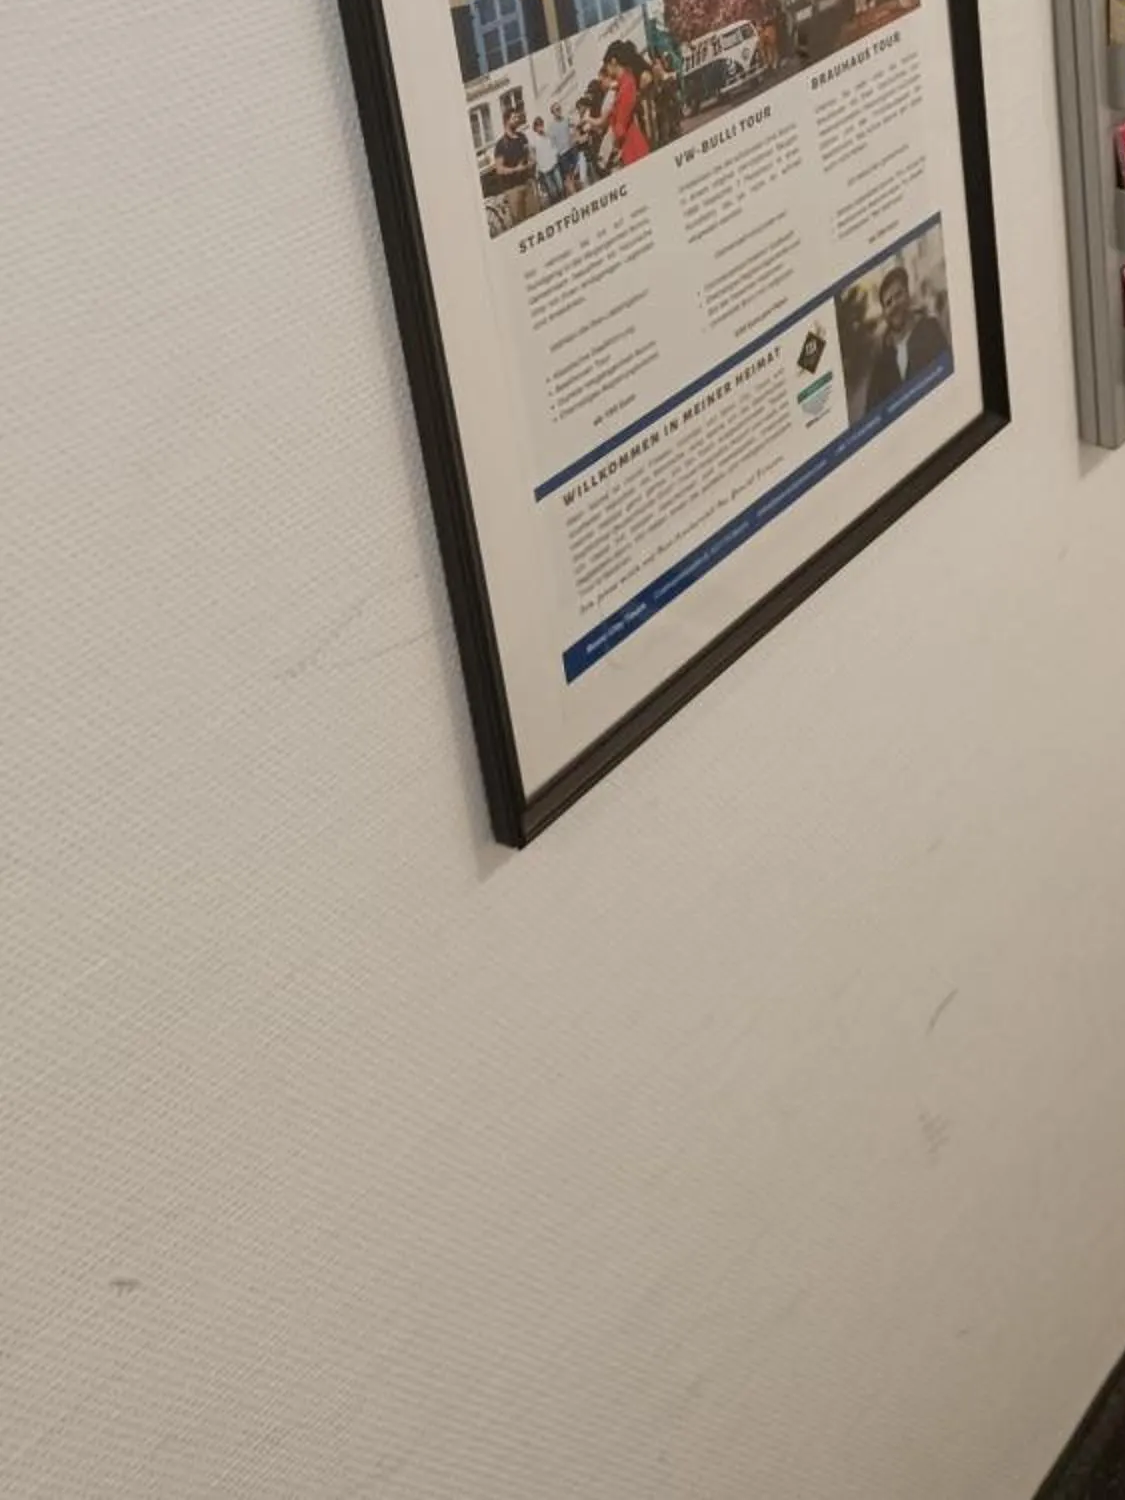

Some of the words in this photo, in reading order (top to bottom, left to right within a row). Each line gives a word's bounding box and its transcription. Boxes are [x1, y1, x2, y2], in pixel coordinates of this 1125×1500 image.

[811, 47, 871, 90] BRAUHAUS
[873, 30, 901, 54] TOUR
[739, 104, 771, 133] TOUR
[518, 184, 628, 254] STADTFÜHRUNG
[562, 429, 660, 507] WILLKOMMEN
[663, 418, 679, 437] IN
[683, 382, 733, 424] MEINER
[735, 345, 782, 387] HEIMAT
